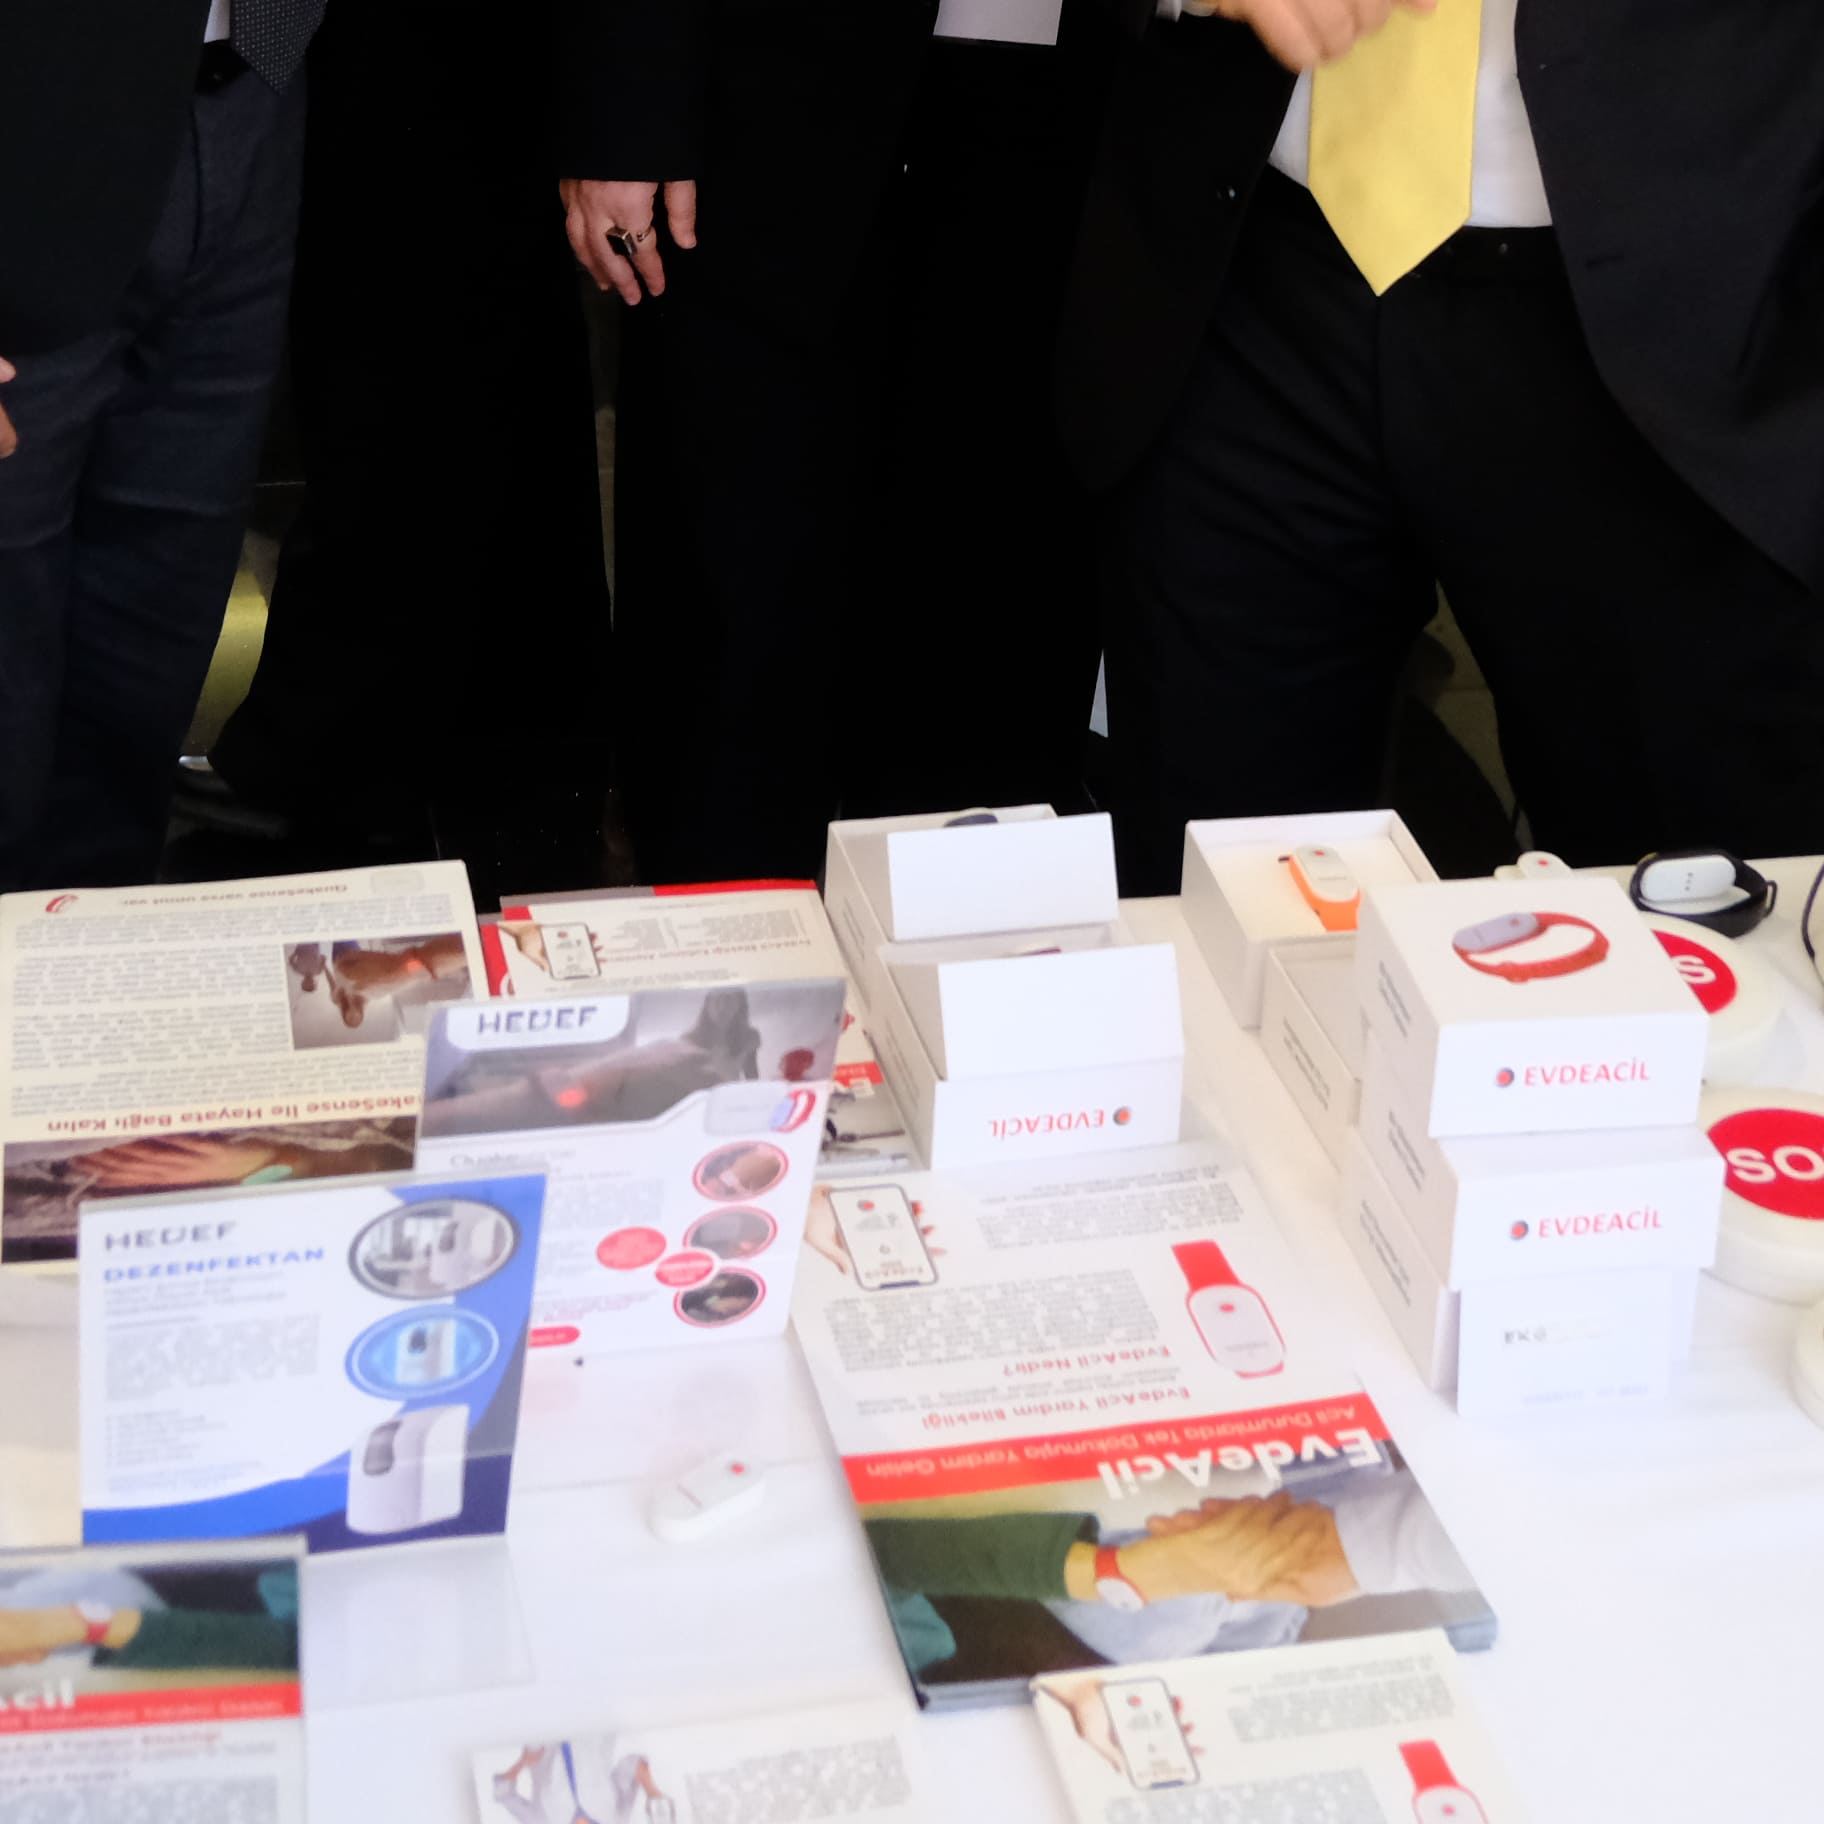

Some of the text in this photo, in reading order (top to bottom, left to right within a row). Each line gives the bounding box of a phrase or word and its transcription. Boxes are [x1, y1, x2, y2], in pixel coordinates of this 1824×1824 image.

[1523, 1056, 1650, 1086] EVDEACİL
[306, 1093, 422, 1116] akeSense
[987, 1108, 1105, 1141] EVDEACİL
[1537, 1205, 1664, 1238] EVDEACİL
[1096, 1427, 1383, 1499] EvdeAcil
